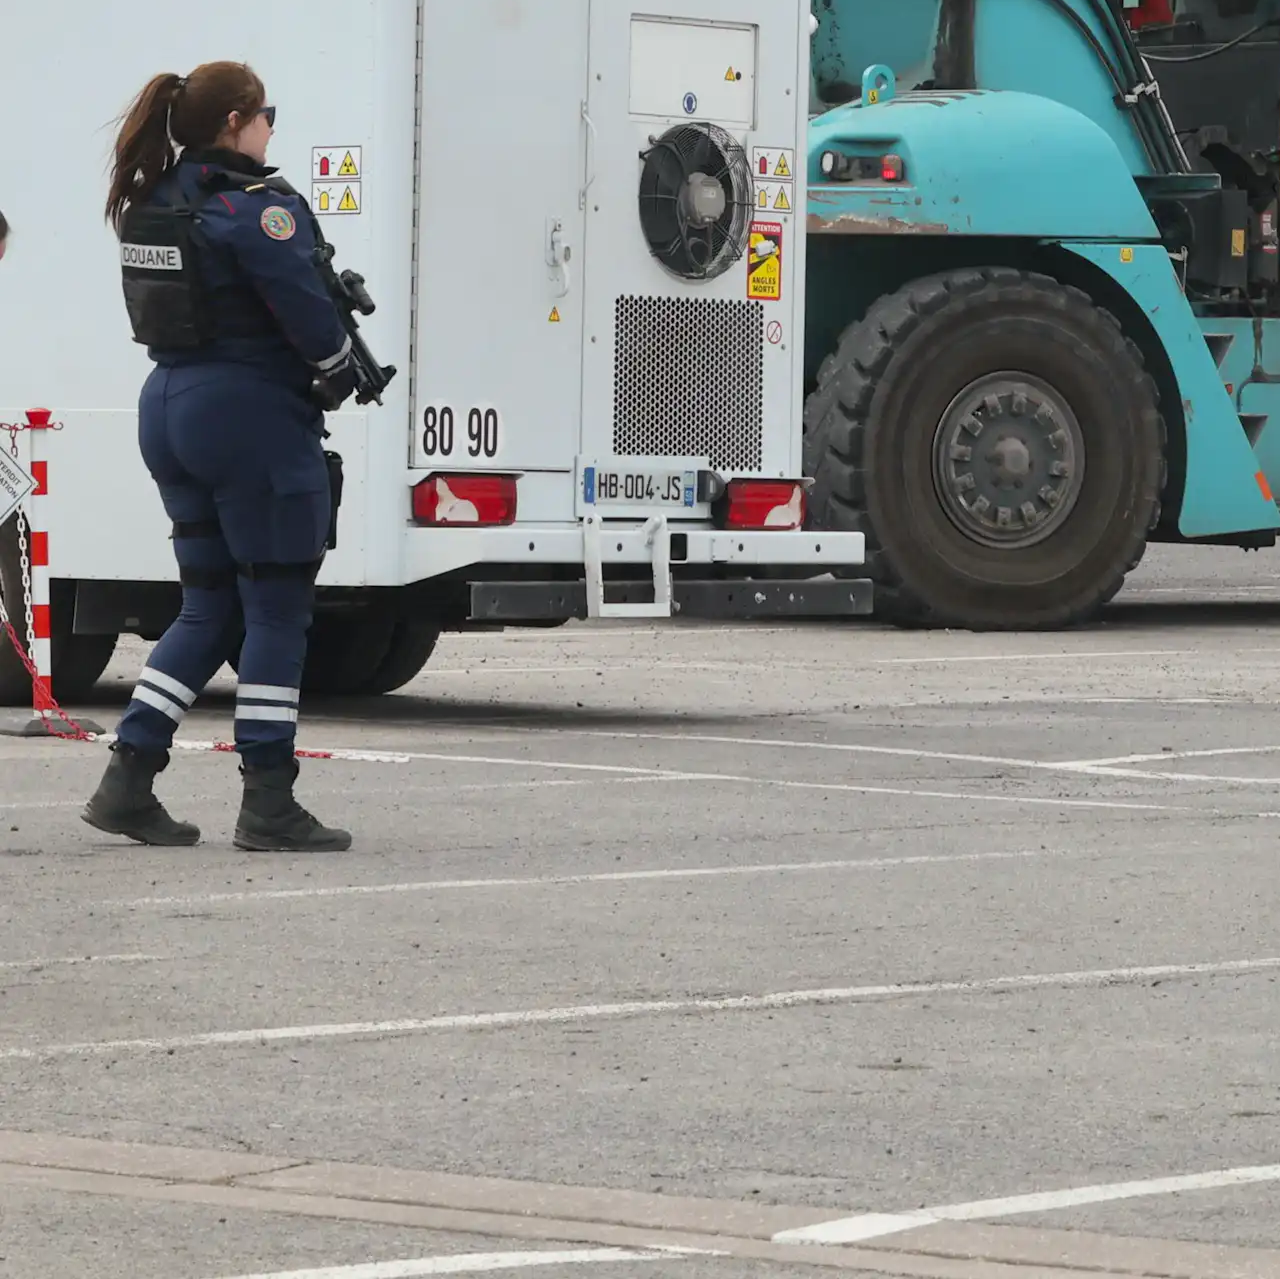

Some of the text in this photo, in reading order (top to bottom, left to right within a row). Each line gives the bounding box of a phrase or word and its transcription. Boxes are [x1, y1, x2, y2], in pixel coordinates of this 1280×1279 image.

[123, 247, 177, 266] DOUANE
[752, 277, 776, 285] ANGLES
[753, 285, 775, 293] MORTS
[422, 405, 498, 458] 80 90
[598, 473, 681, 501] HB-004-JS
